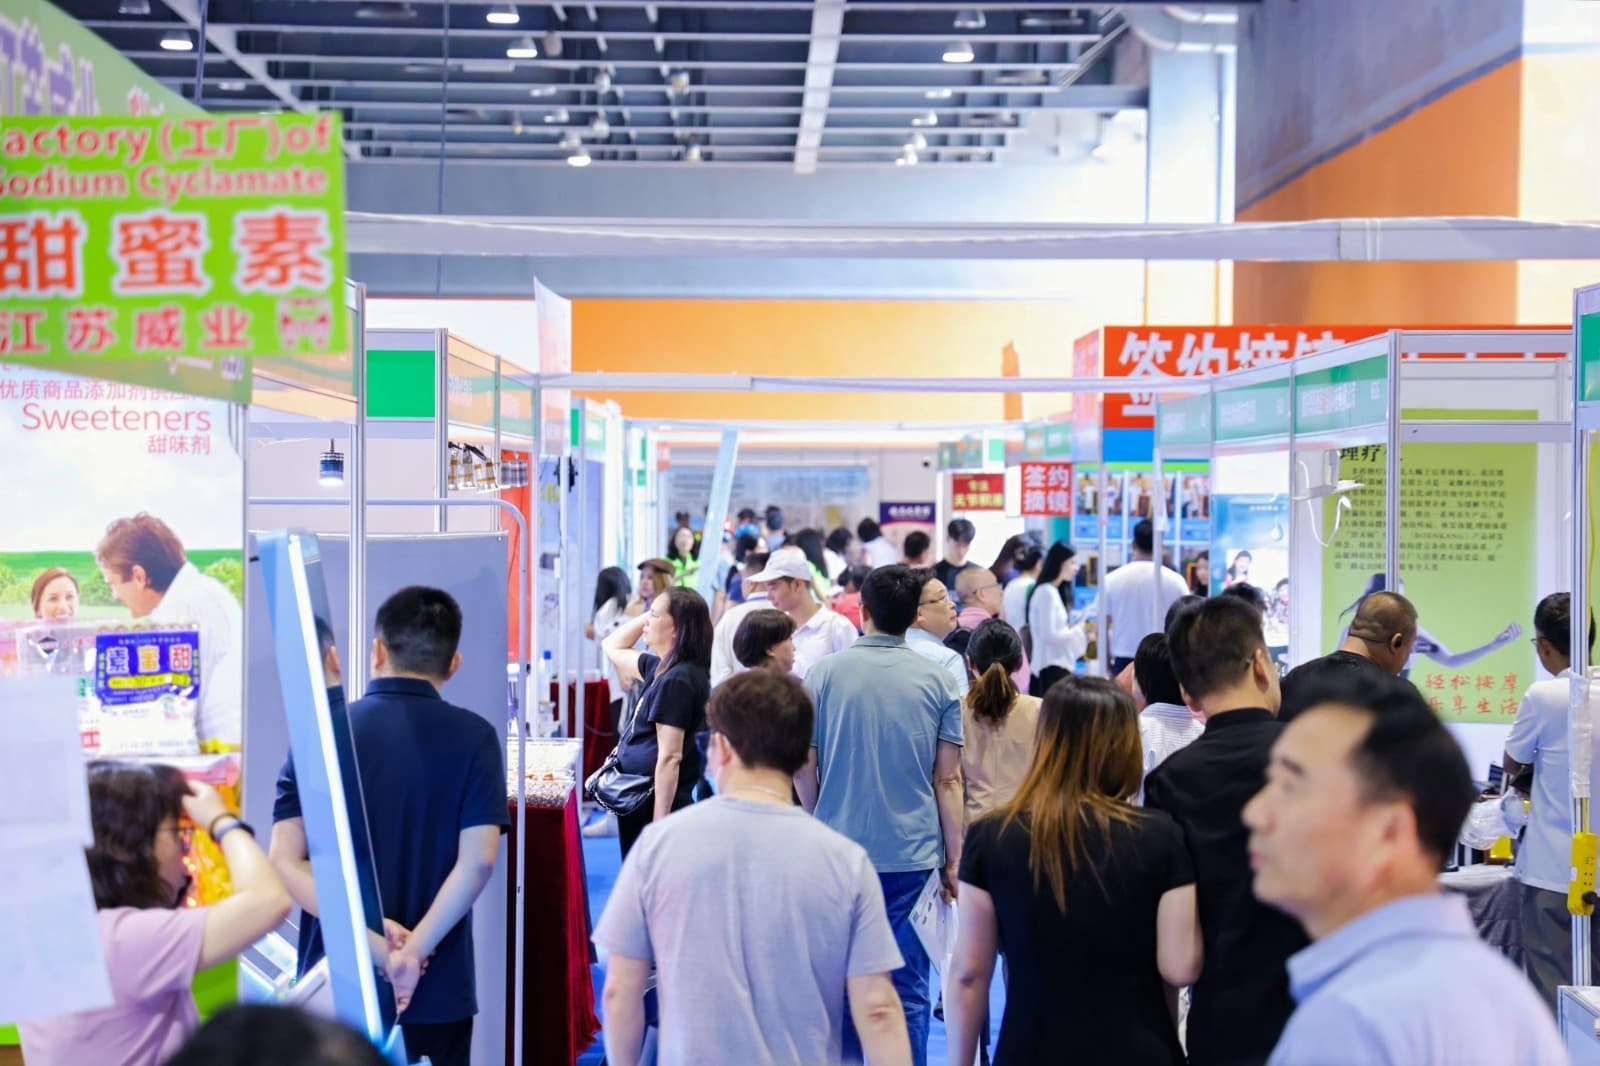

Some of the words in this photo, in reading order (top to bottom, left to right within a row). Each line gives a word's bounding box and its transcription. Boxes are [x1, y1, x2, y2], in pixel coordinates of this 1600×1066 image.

[0, 124, 149, 162] actory
[138, 165, 326, 205] Cyclamate
[0, 211, 326, 292] 甜蜜素
[22, 403, 211, 431] Sweeteners
[147, 435, 210, 455] 甜味剂
[1023, 465, 1070, 487] 签约
[1426, 673, 1520, 692] 轻松按摩
